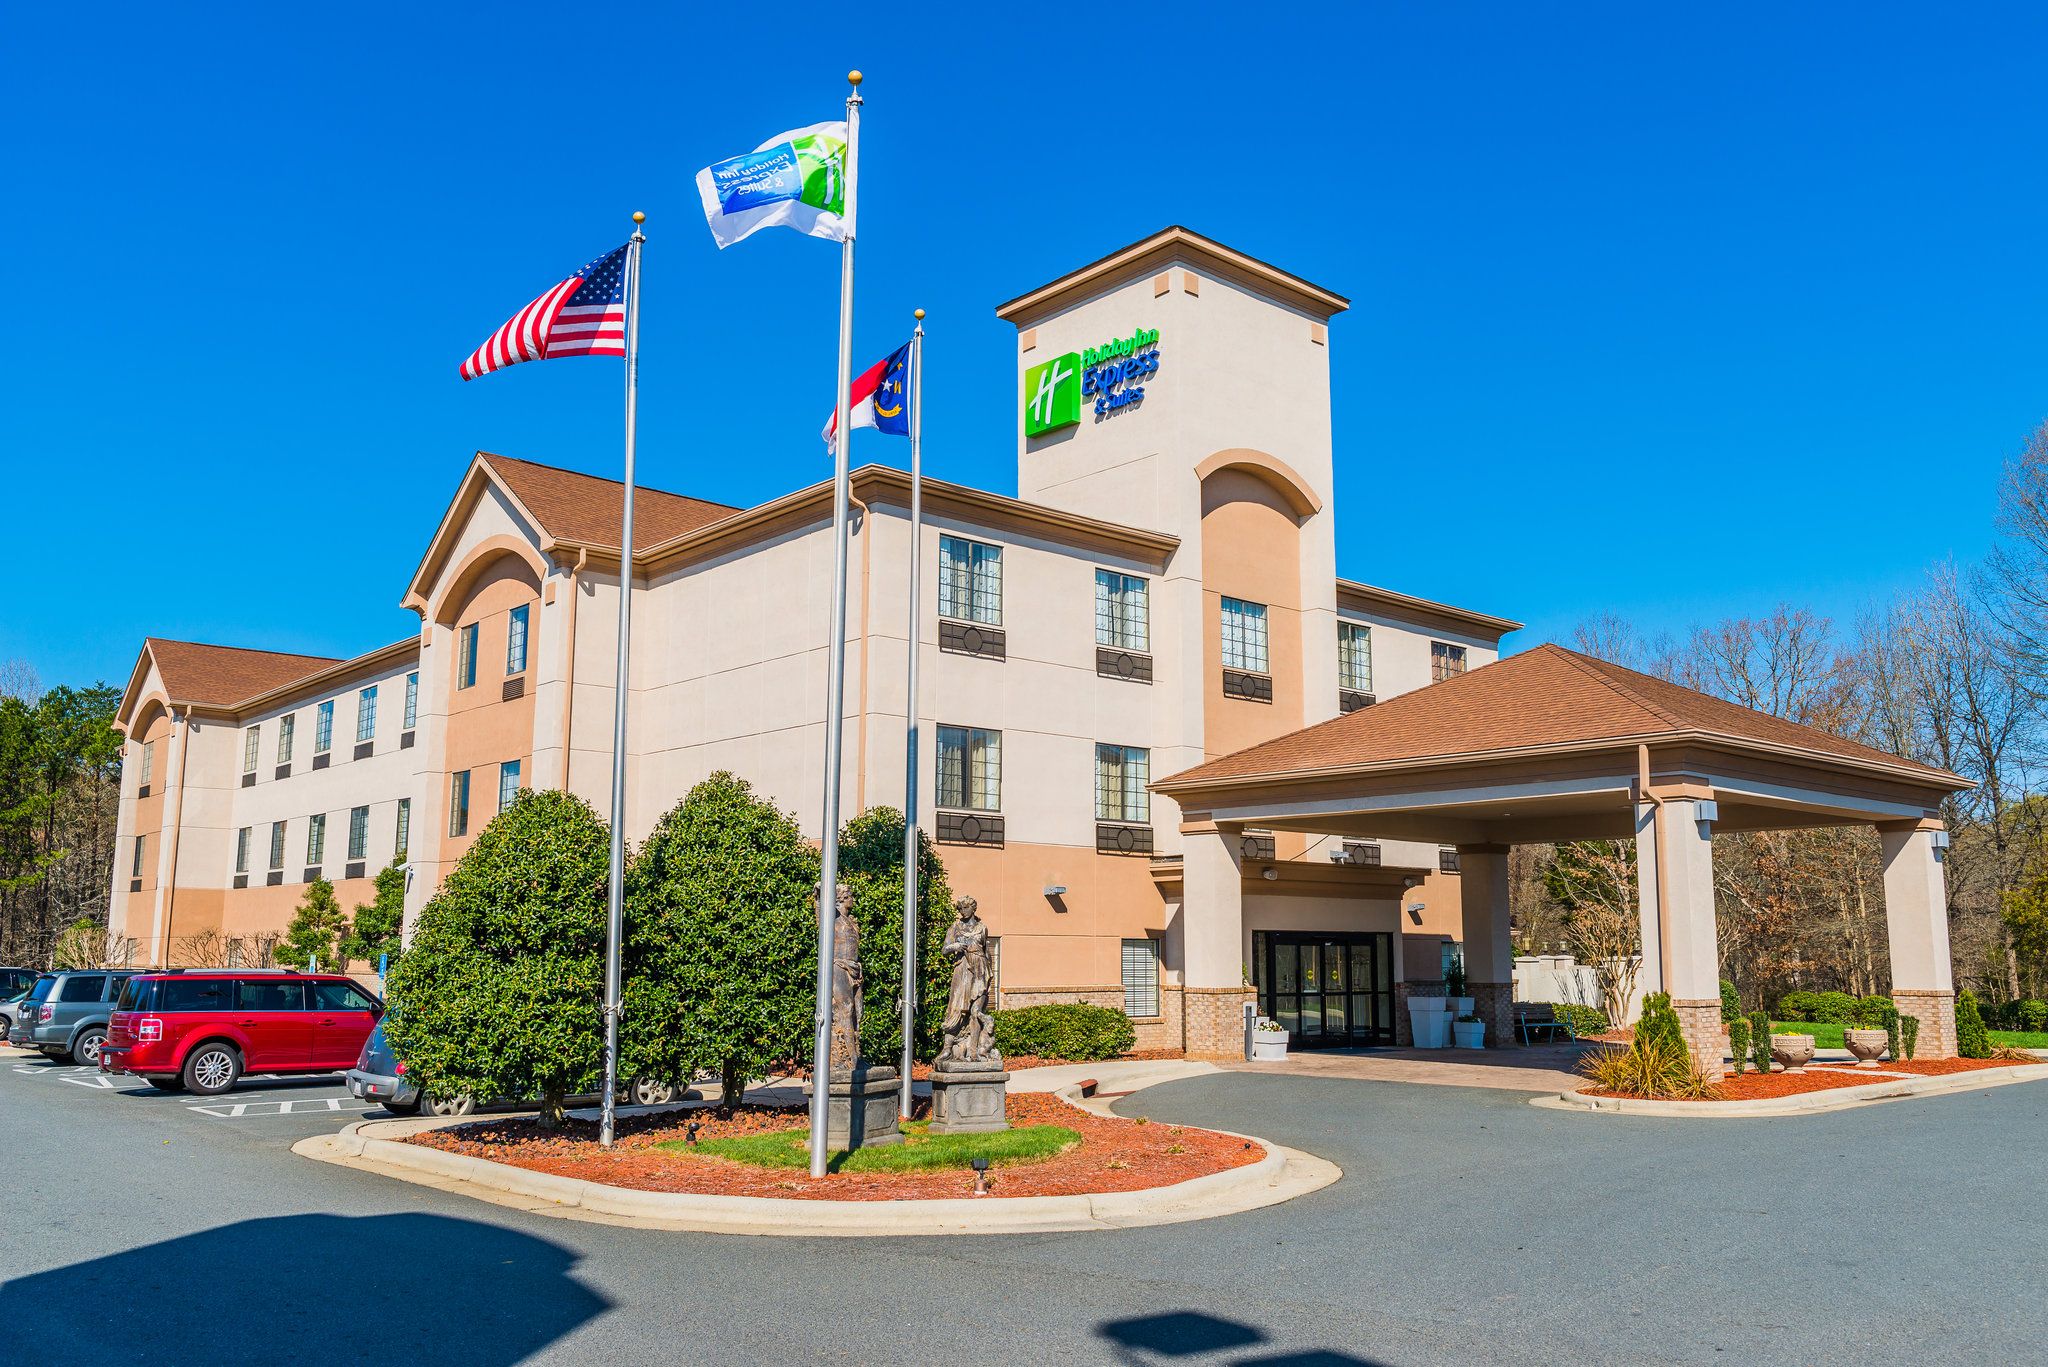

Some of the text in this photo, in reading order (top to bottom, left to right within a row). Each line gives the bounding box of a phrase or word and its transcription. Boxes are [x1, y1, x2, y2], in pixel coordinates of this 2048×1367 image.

[1081, 327, 1160, 369] Holiday Inn
[1081, 350, 1161, 396] Express
[1094, 387, 1146, 416] & Suites
